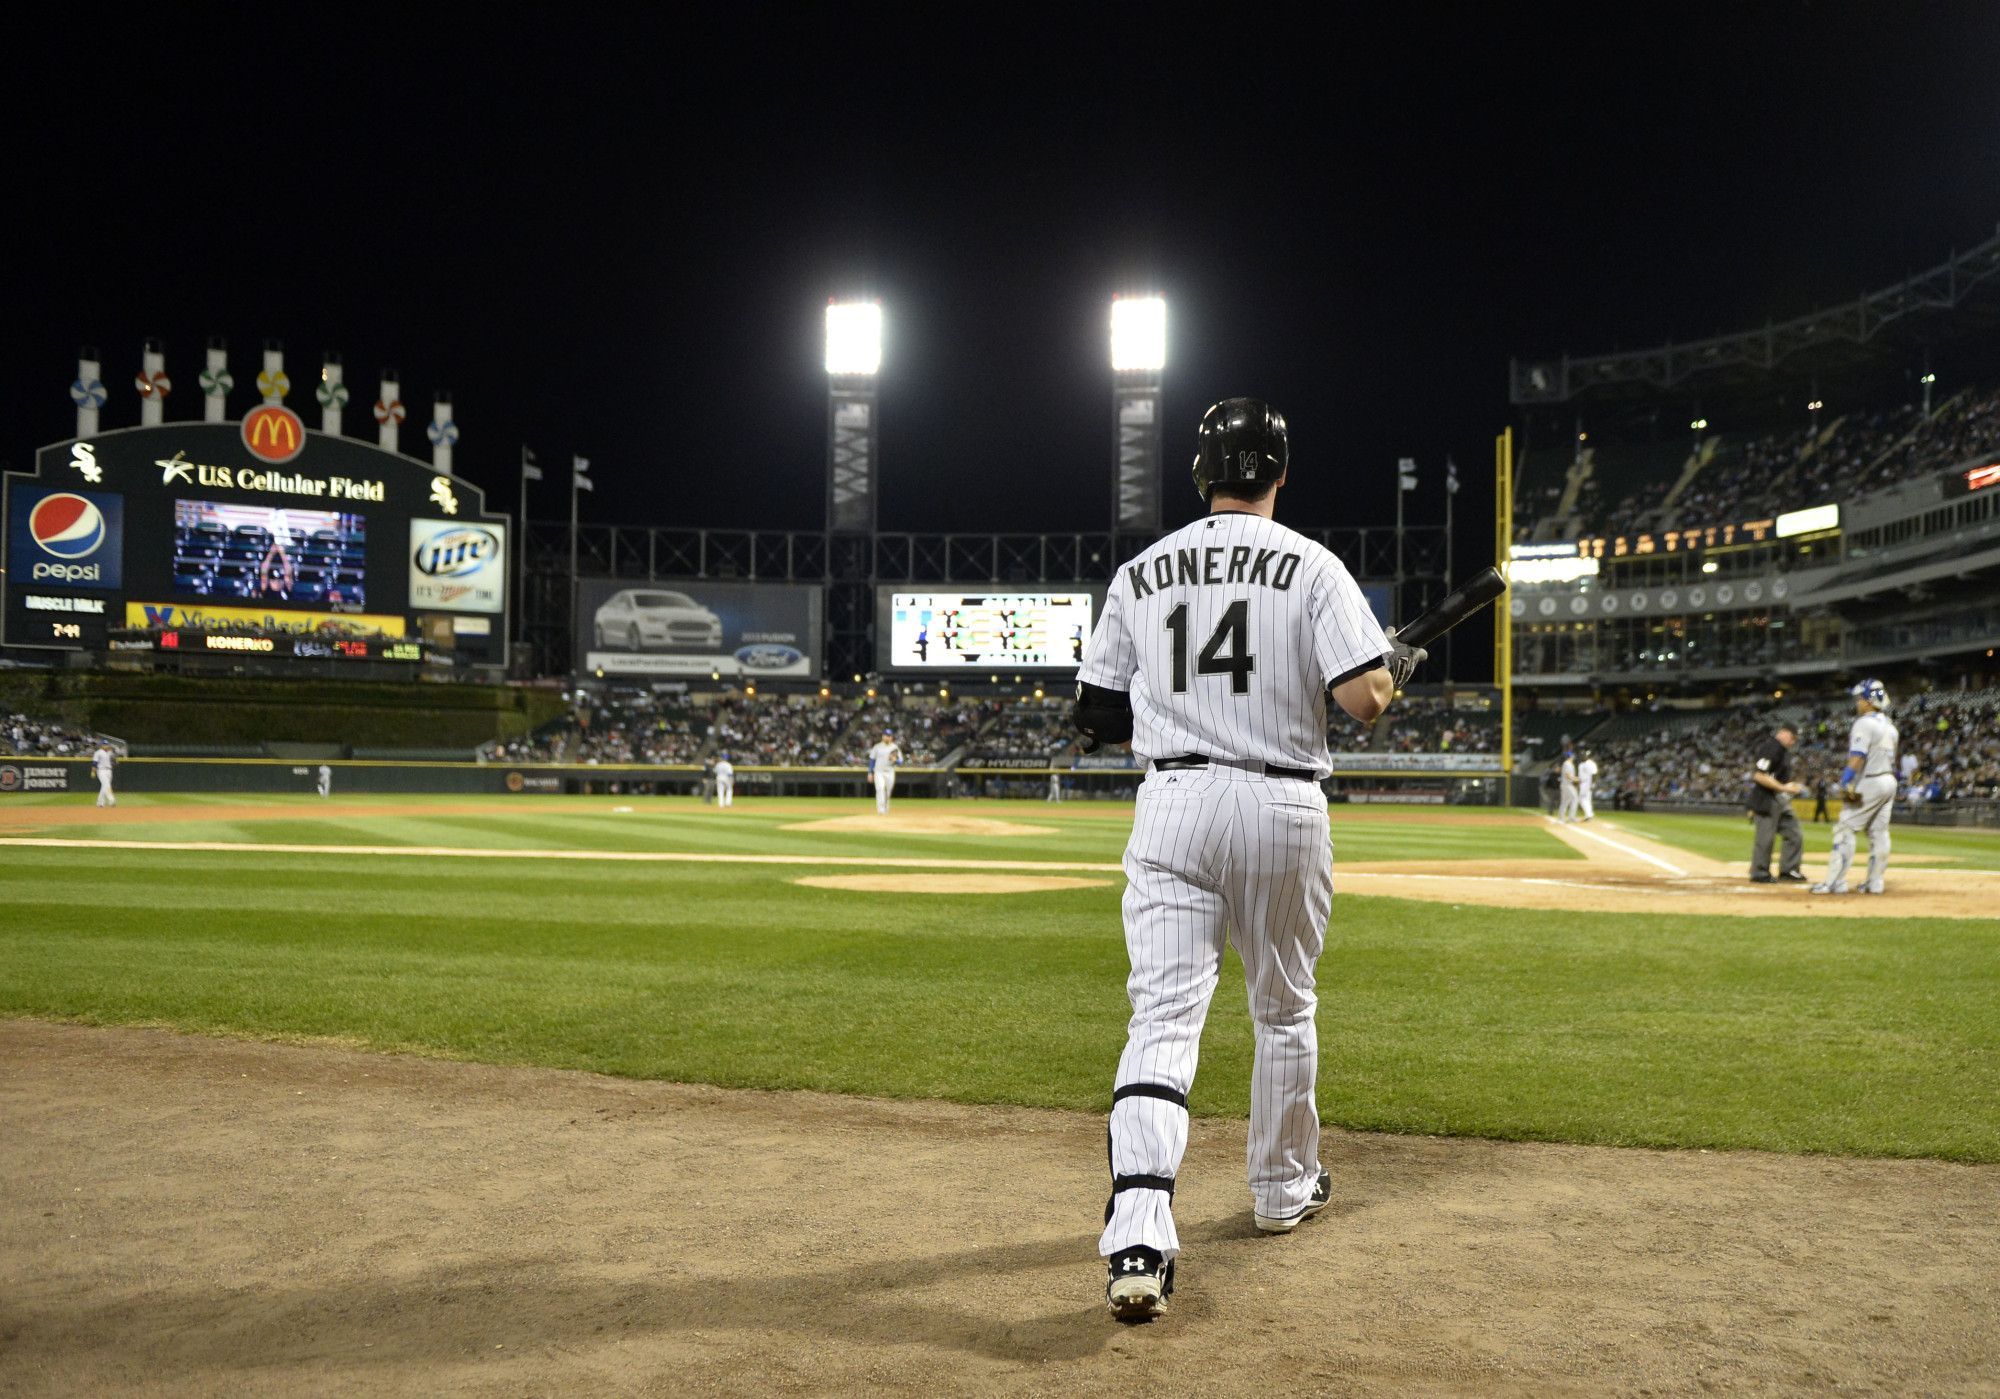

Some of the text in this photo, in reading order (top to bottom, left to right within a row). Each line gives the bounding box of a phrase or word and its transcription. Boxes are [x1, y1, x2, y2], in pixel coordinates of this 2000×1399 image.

[1239, 451, 1258, 470] 14
[237, 468, 327, 496] Cellular
[329, 476, 384, 501] Field
[33, 562, 100, 582] pepsi
[1128, 545, 1302, 600] KONERKO
[206, 635, 274, 651] KONERKO
[1163, 598, 1256, 696] 14
[987, 759, 1048, 768] HYUNDAI
